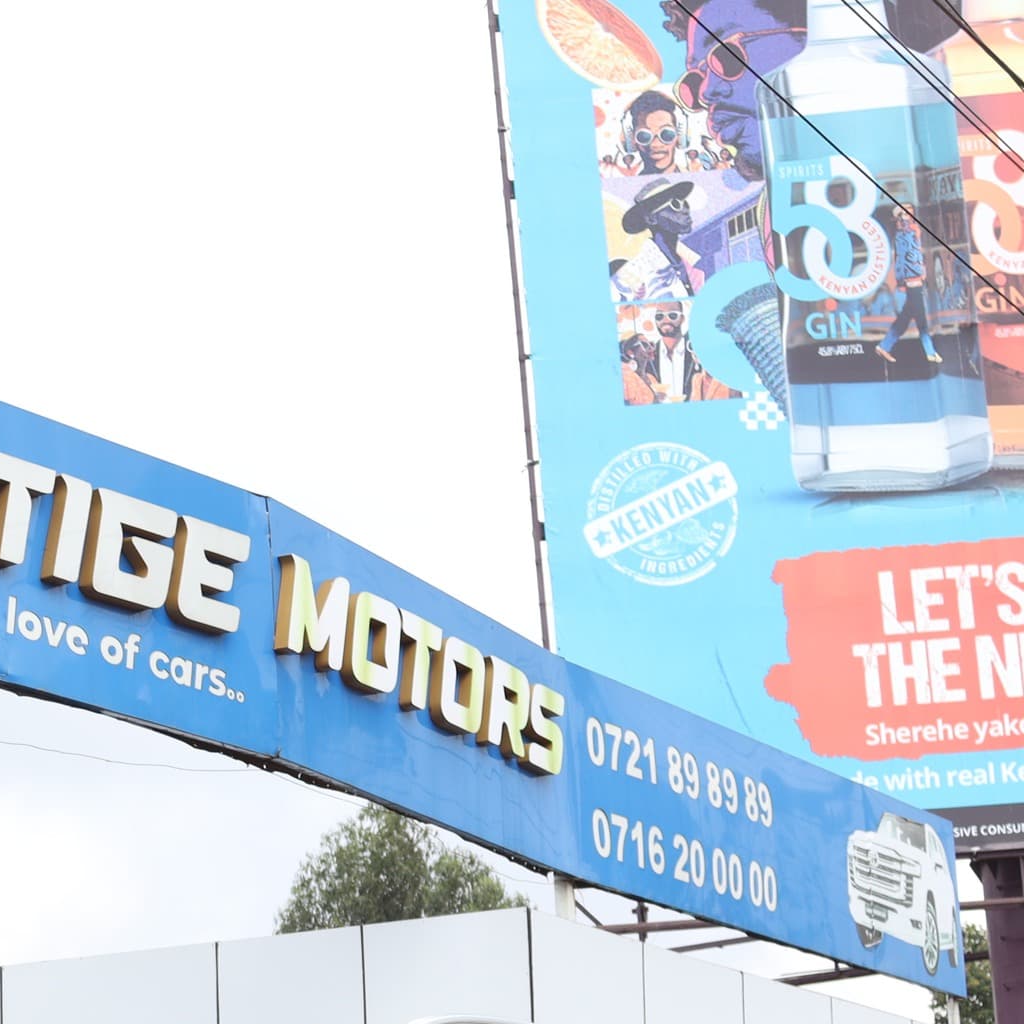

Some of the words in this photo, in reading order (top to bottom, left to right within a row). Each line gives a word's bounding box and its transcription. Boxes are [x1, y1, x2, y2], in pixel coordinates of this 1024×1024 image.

[778, 163, 824, 179] SPIRITS
[772, 155, 891, 302] 58
[818, 275, 868, 296] KENYAN
[861, 220, 885, 283] DISTILLED
[805, 310, 863, 340] GIN
[597, 451, 653, 513] DISTILLED
[658, 449, 699, 473] WITH
[610, 477, 711, 543] KENYAN
[639, 520, 726, 575] INGREDIENTS
[5, 595, 89, 655] love
[100, 633, 141, 670] of
[273, 553, 565, 778] MOTORS
[852, 637, 967, 708] THE
[865, 717, 970, 746] Sherehe
[586, 716, 658, 785] 0721
[666, 746, 700, 800] 89
[706, 761, 738, 815] 89
[744, 776, 773, 828] 89
[884, 765, 941, 791] with
[946, 761, 996, 787] real
[592, 808, 665, 875] 0716
[672, 833, 706, 888] 20
[712, 847, 744, 900] 00
[749, 860, 777, 912] 00
